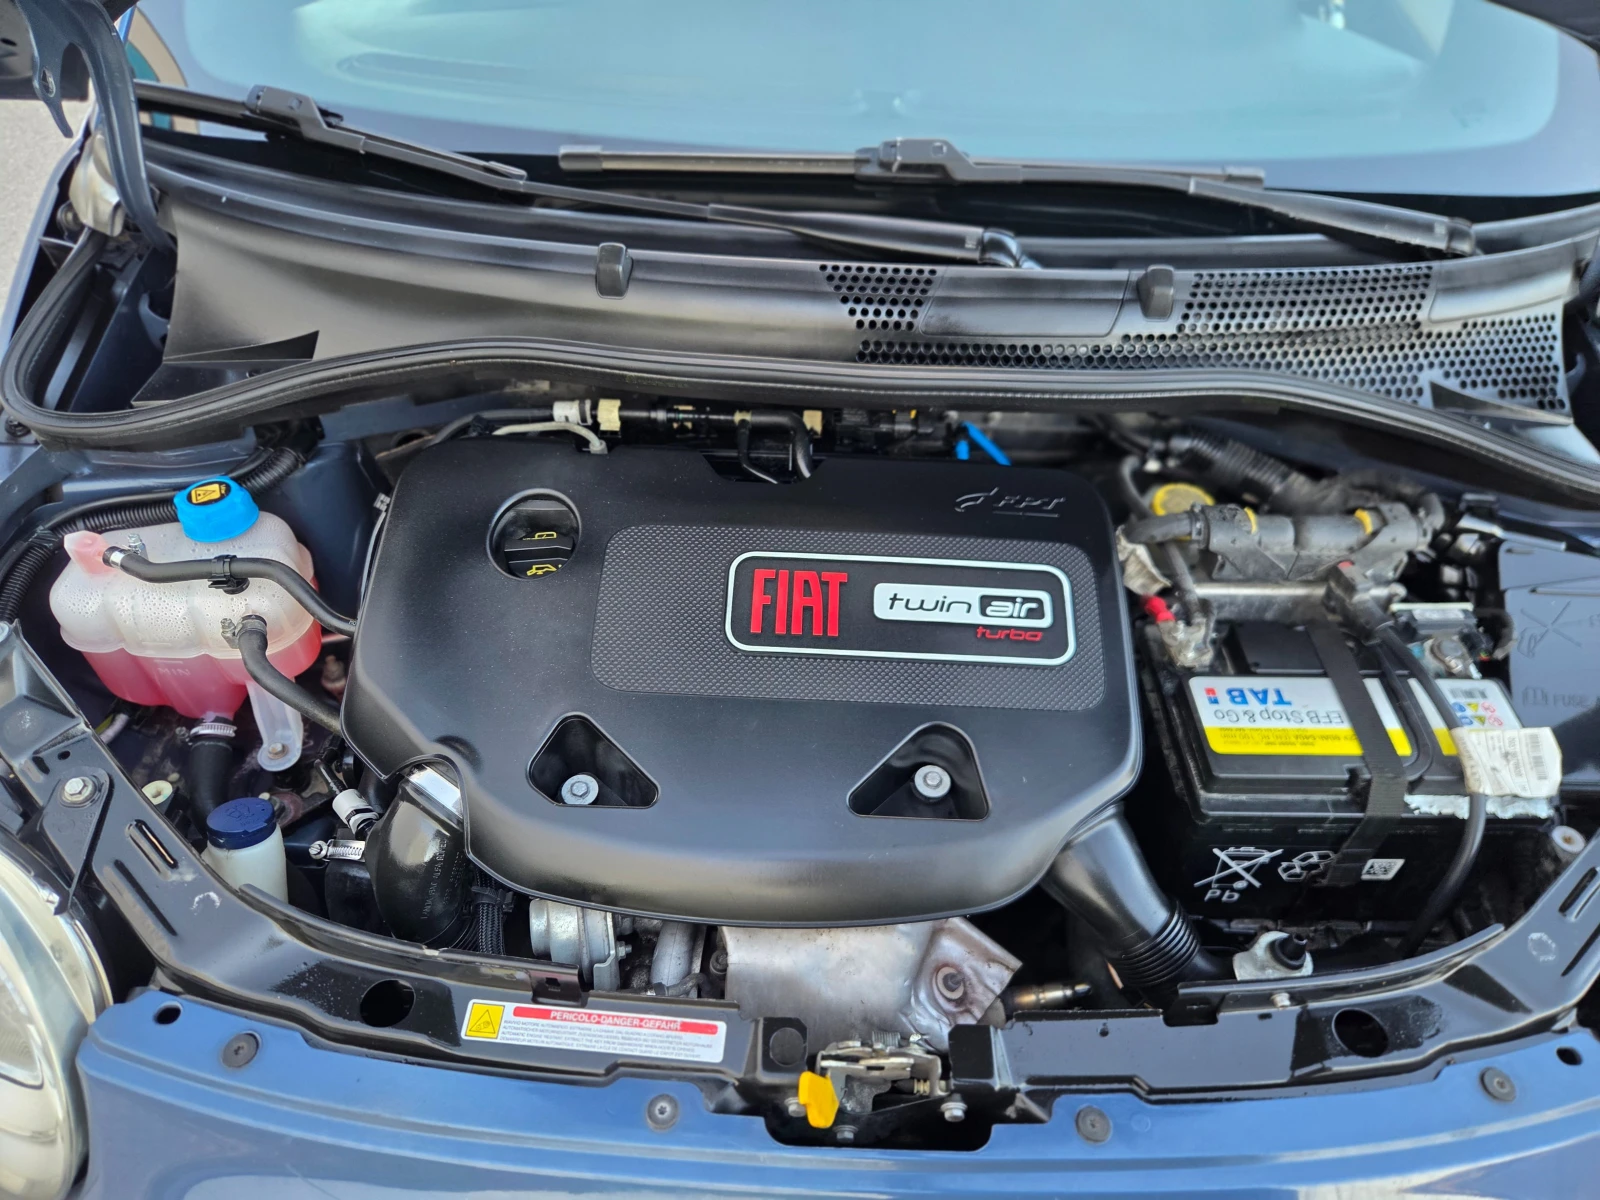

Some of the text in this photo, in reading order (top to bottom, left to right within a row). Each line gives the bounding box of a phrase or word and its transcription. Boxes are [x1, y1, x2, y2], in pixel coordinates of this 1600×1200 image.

[750, 568, 848, 637] FIAT
[888, 592, 1039, 619] twin air
[976, 626, 1043, 642] turbo
[157, 667, 191, 676] MIN
[1226, 687, 1292, 706] TAB
[1213, 707, 1345, 724] EFB Stop & Go
[1204, 889, 1240, 903] Pb
[550, 1010, 682, 1030] PERICOLO-DANGER-GEFAHR
